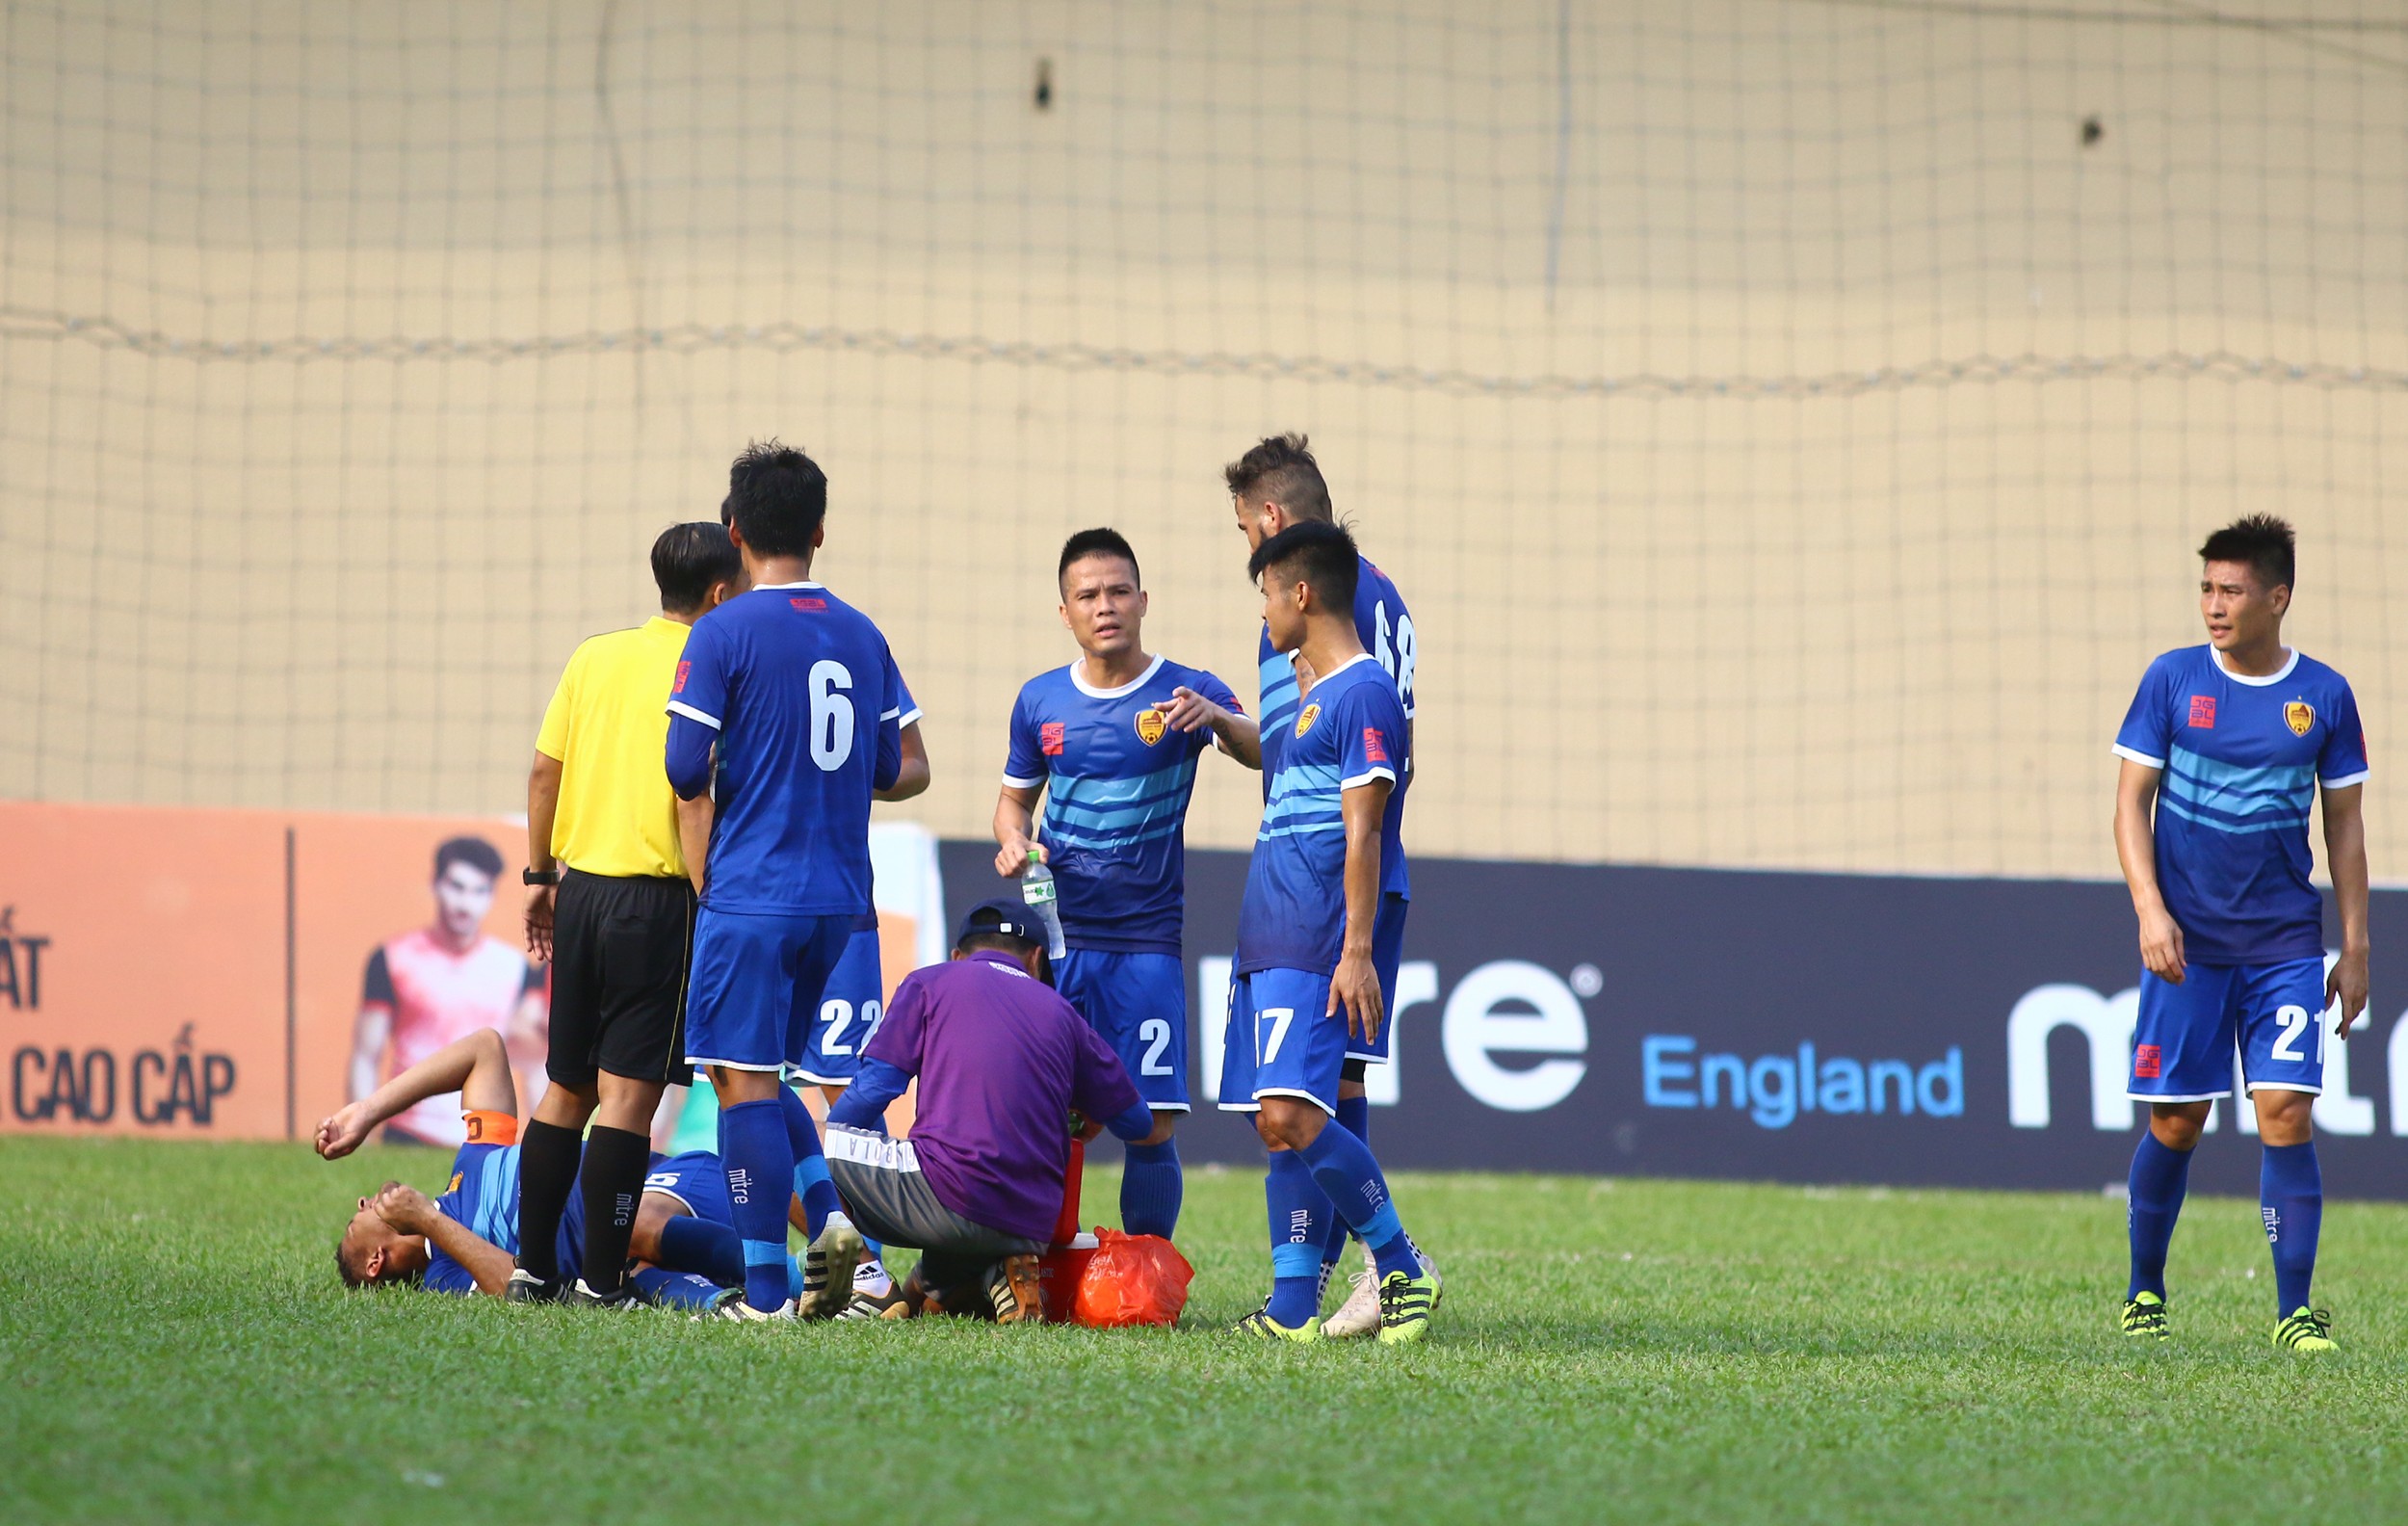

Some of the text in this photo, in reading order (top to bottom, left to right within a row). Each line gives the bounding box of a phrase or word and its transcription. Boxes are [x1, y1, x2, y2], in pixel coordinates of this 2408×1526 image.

[808, 660, 854, 771] 6
[821, 998, 882, 1056] 22
[1139, 1018, 1174, 1076] 2
[2271, 1005, 2325, 1065] 21
[12, 1022, 236, 1125] CAO CẤP
[1641, 1034, 1965, 1130] England
[615, 1193, 635, 1225] mitre
[728, 1169, 753, 1204] mitre
[1291, 1209, 1312, 1244] mitre
[2263, 1207, 2280, 1243] mitre
